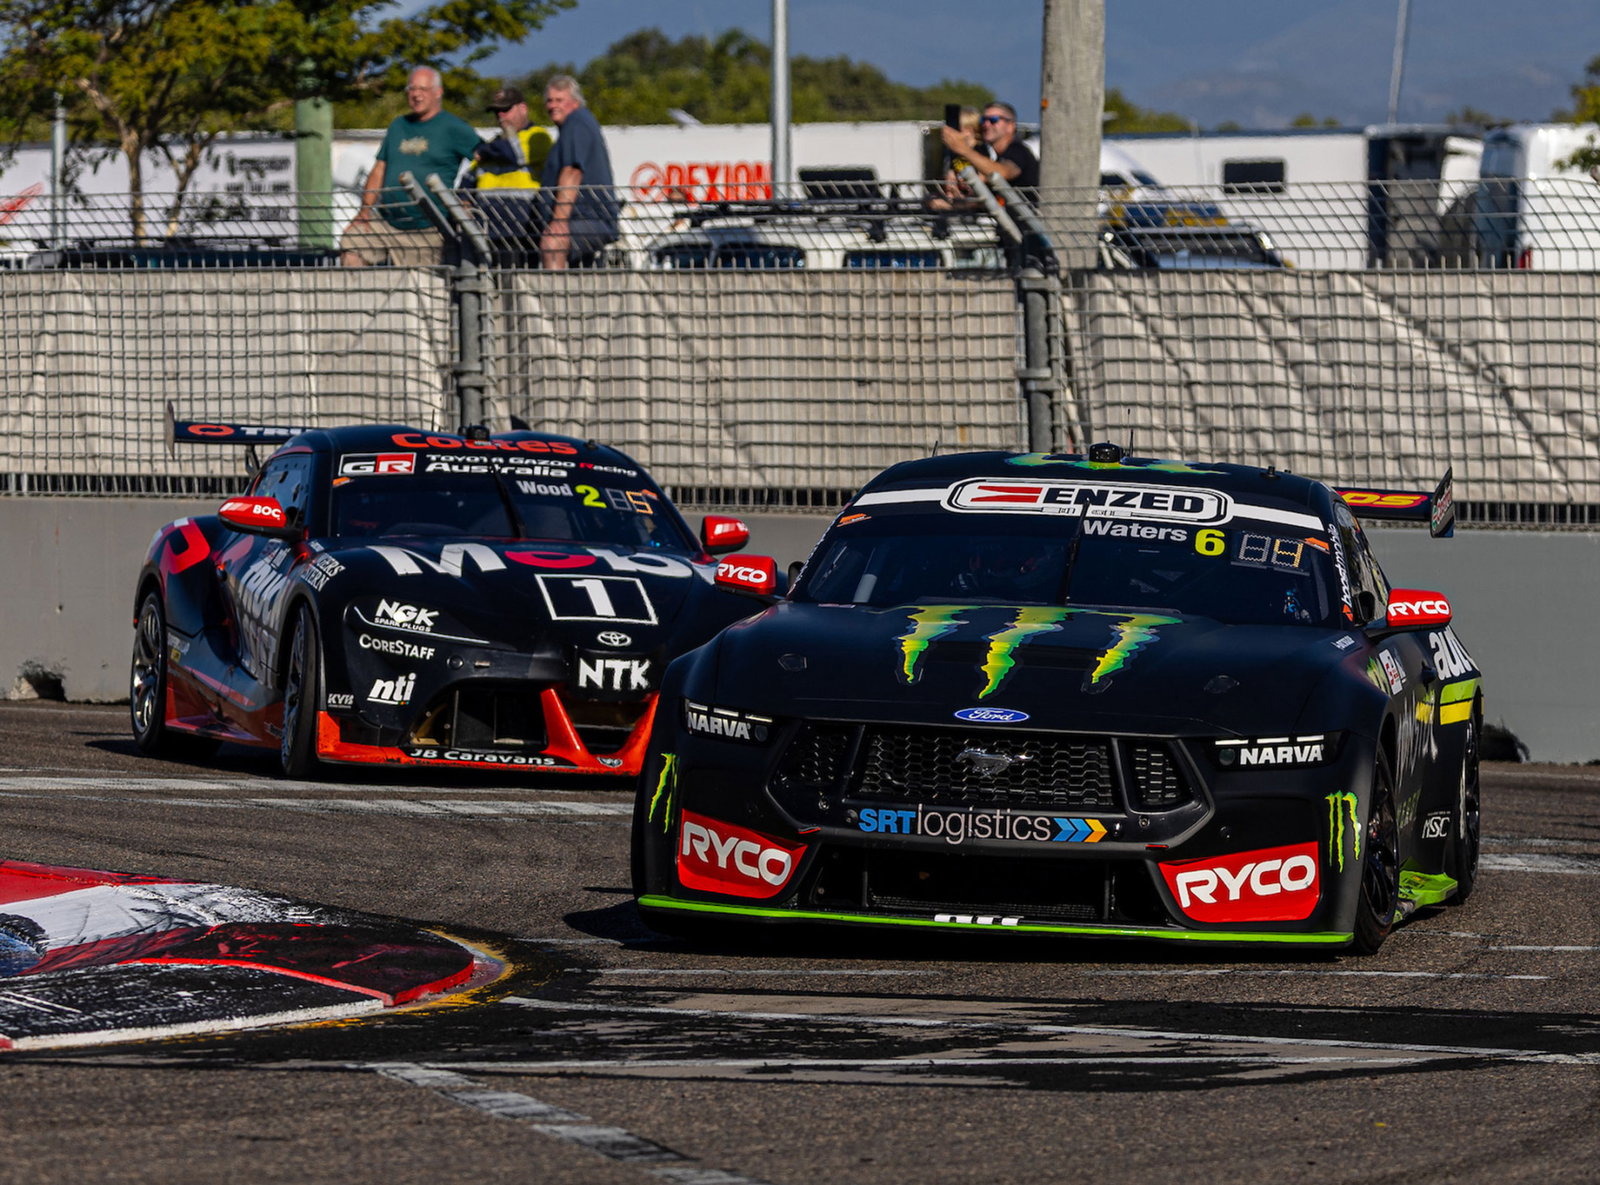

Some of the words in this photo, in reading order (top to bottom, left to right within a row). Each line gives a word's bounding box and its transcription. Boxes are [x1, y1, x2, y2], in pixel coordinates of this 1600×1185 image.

[342, 460, 413, 475] GR
[516, 480, 574, 497] Wood
[575, 484, 607, 508] 2
[1043, 486, 1205, 514] ENZED
[253, 504, 281, 520] BOC
[1083, 519, 1188, 542] Waters
[1194, 528, 1226, 557] 6
[375, 598, 440, 627] NGK
[571, 579, 617, 618] 1
[1387, 600, 1450, 617] RYCO
[402, 622, 432, 633] PLUGS
[578, 657, 652, 691] NTK
[686, 711, 751, 740] NARVA
[968, 707, 1014, 723] Ford
[410, 748, 435, 759] JB
[443, 750, 556, 766] Caravans
[1240, 745, 1323, 766] NARVA
[682, 821, 791, 887] RYCO
[1176, 854, 1316, 909] RYCO
